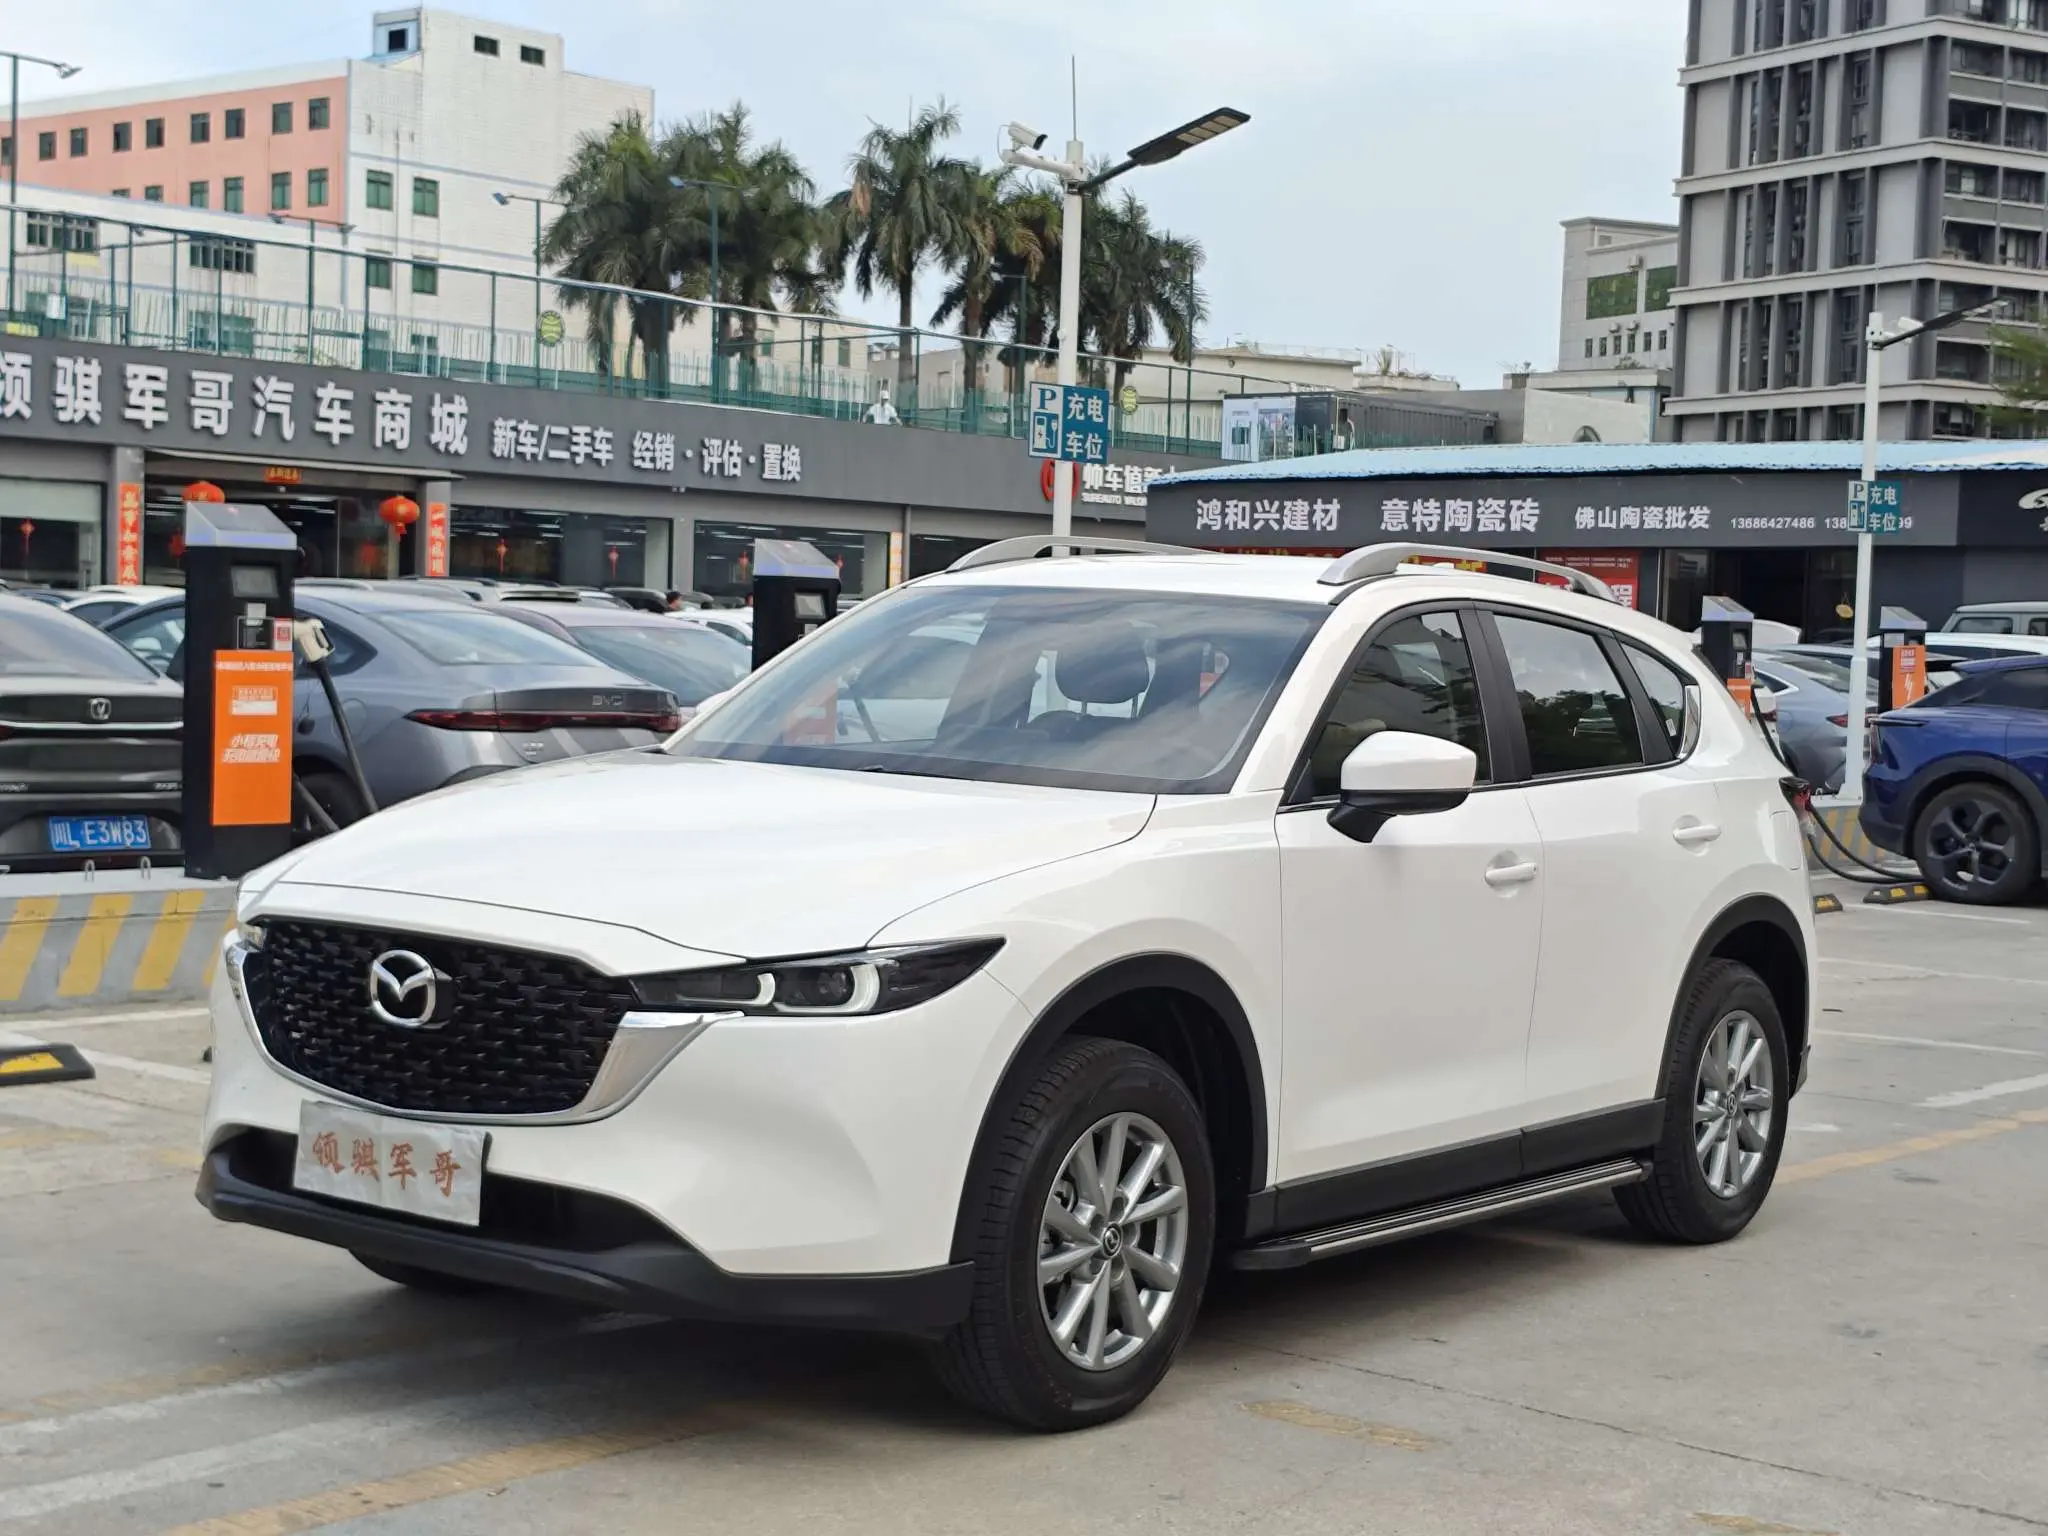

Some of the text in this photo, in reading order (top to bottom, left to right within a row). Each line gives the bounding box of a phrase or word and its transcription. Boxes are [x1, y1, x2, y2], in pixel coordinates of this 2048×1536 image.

[1037, 388, 1057, 410] P
[1067, 393, 1104, 422] 充电
[492, 416, 614, 467] 新车/二手车
[1065, 431, 1103, 459] 车位
[1853, 484, 1864, 499] P
[1869, 485, 1897, 505] 充电
[1196, 498, 1341, 532] 鸿和兴建材
[1380, 498, 1540, 532] 意特陶瓷砖
[1574, 506, 1711, 530] 佛山陶瓷批发
[1868, 511, 1897, 531] 车位
